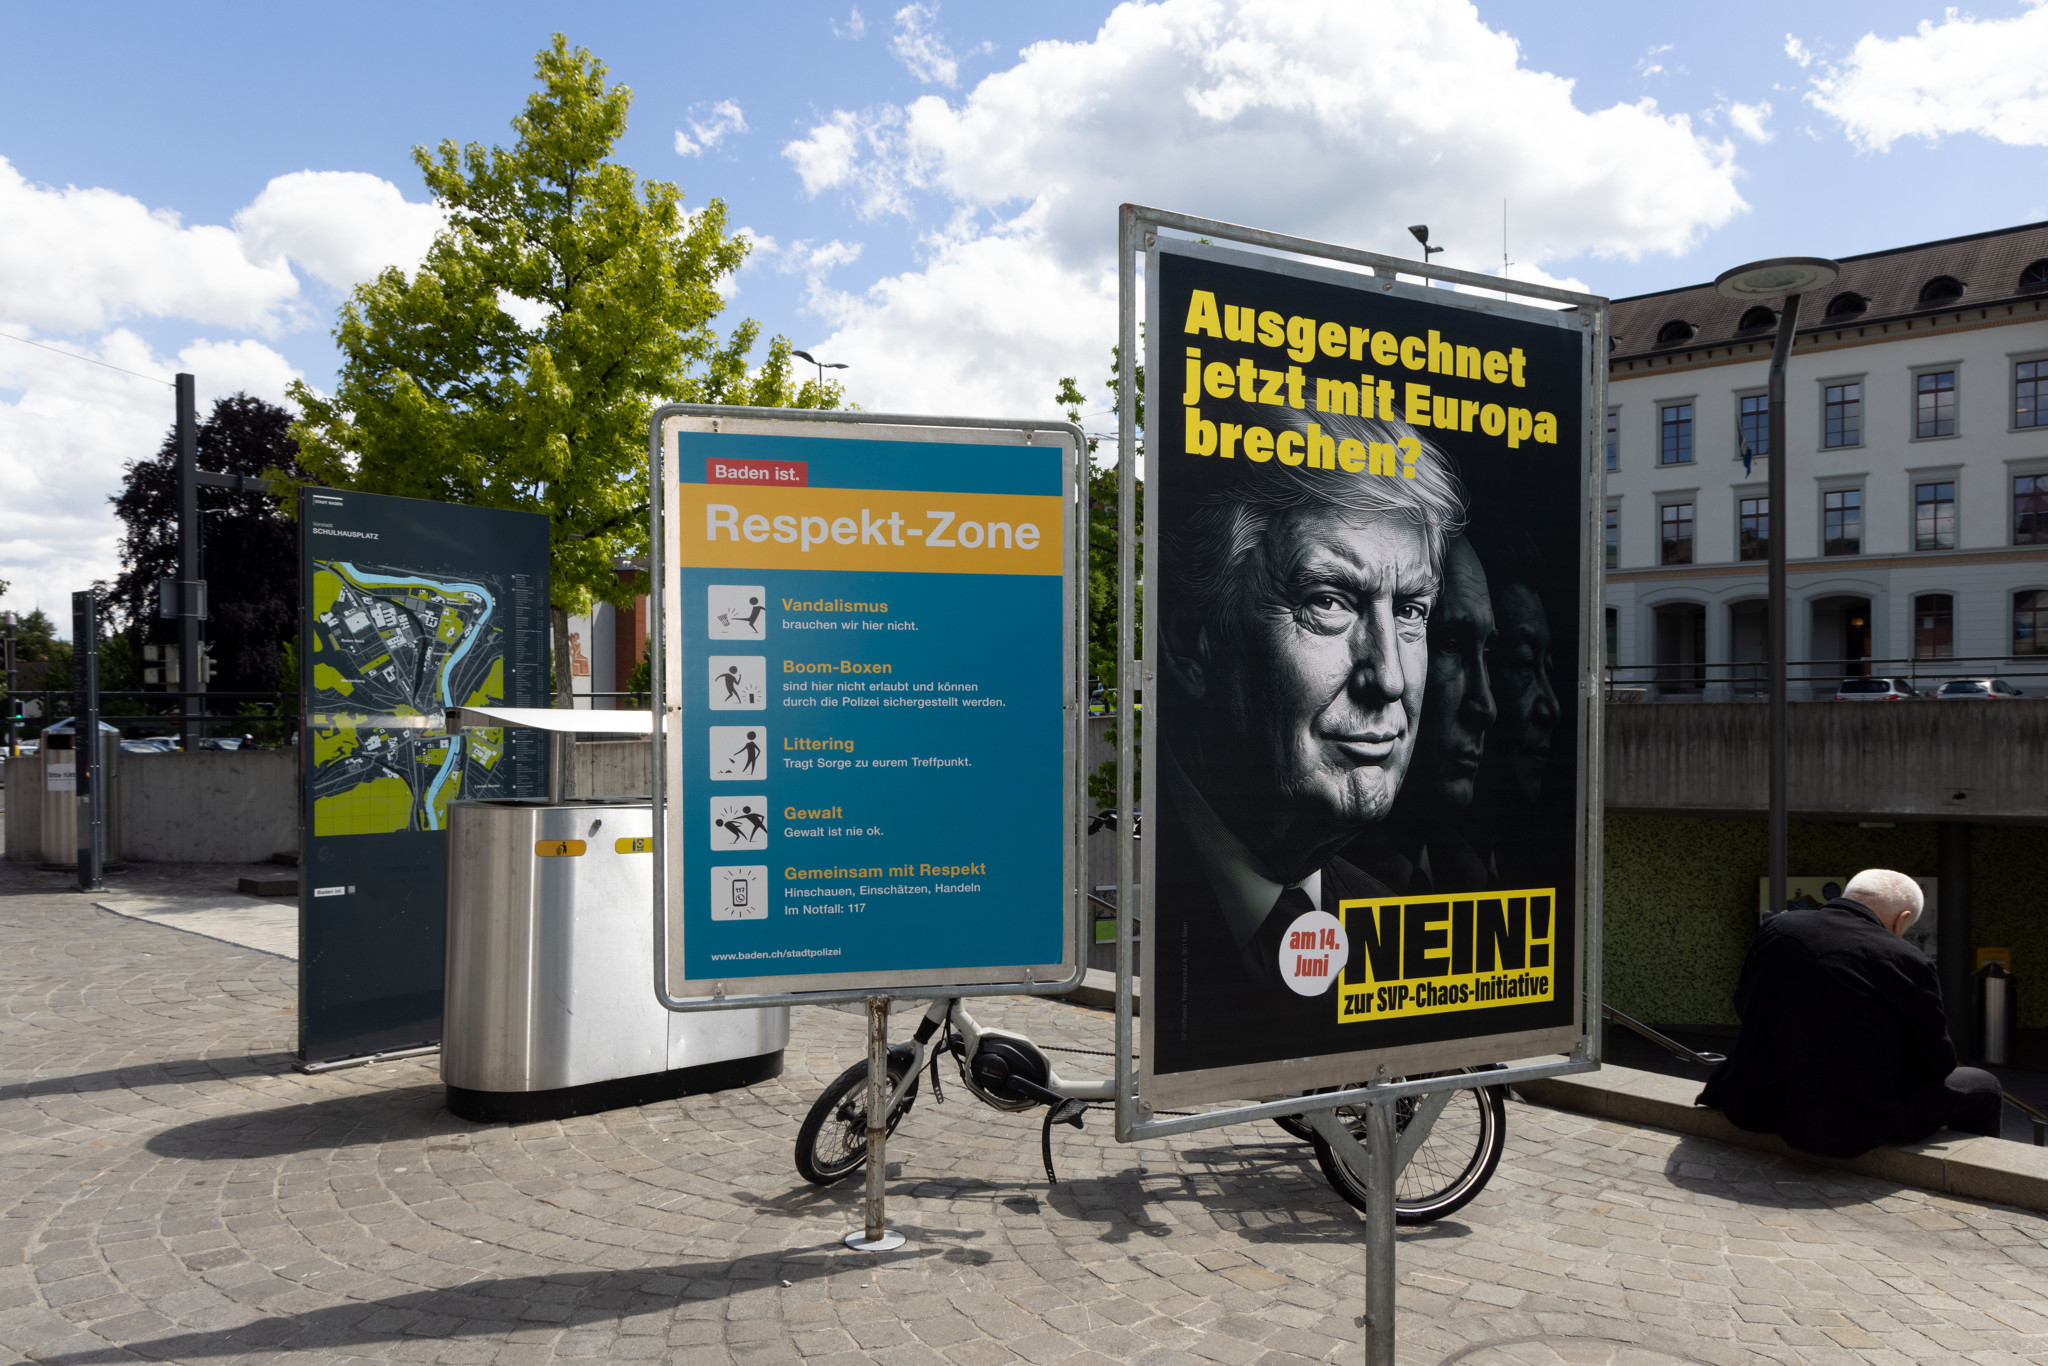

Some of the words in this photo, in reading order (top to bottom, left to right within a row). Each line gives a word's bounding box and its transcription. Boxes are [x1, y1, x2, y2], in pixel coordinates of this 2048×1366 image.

[1184, 289, 1526, 388] Ausgerechnet
[1183, 347, 1306, 408] jetzt
[1316, 374, 1394, 422] mit
[1406, 382, 1557, 449] Europa
[1184, 407, 1421, 479] brechen?
[715, 465, 769, 480] Baden
[775, 465, 799, 481] ist.
[312, 528, 379, 540] SCHULHAUSPLATZ
[706, 504, 1040, 552] Respekt-Zone
[782, 598, 888, 612] Vandalismus
[783, 619, 837, 629] brauchen
[841, 620, 859, 629] wir
[862, 620, 884, 630] hier
[888, 621, 918, 630] nicht.
[783, 660, 891, 673] Boom-Boxen
[783, 681, 807, 691] sind
[812, 681, 833, 691] hier
[837, 681, 865, 691] nicht
[869, 682, 908, 691] erlaubt
[913, 682, 933, 691] und
[938, 682, 978, 691] können
[783, 697, 816, 706] durch
[821, 697, 838, 706] die
[842, 697, 879, 706] Polizei
[883, 697, 958, 708] sichergestellt
[962, 698, 1005, 706] werden.
[784, 737, 854, 753] Littering
[783, 758, 813, 770] Tragt
[817, 758, 851, 770] Sorge
[912, 757, 971, 768] Treffpunkt.
[784, 806, 842, 819] Gewalt
[784, 827, 824, 837] Gewalt
[829, 827, 841, 836] ist
[846, 826, 863, 836] nie
[867, 826, 883, 835] ok.
[785, 866, 882, 880] Gemeinsam
[889, 864, 914, 877] mit
[920, 863, 986, 878] Respekt
[785, 887, 855, 897] Hinschauen,
[860, 885, 930, 895] Einschätzen,
[935, 883, 980, 893] Handeln
[785, 906, 798, 915] Im
[803, 904, 843, 914] Notfall:
[848, 903, 866, 912] 117
[1290, 930, 1316, 950] am
[1320, 928, 1340, 950] 14.
[1344, 896, 1551, 986] NEIN!
[711, 948, 841, 960] www.baden.ch/stadtpolizei
[1294, 954, 1328, 978] Juni
[1344, 990, 1374, 1015] zur
[1377, 974, 1549, 1012] SVP-Chaos-Initiative
